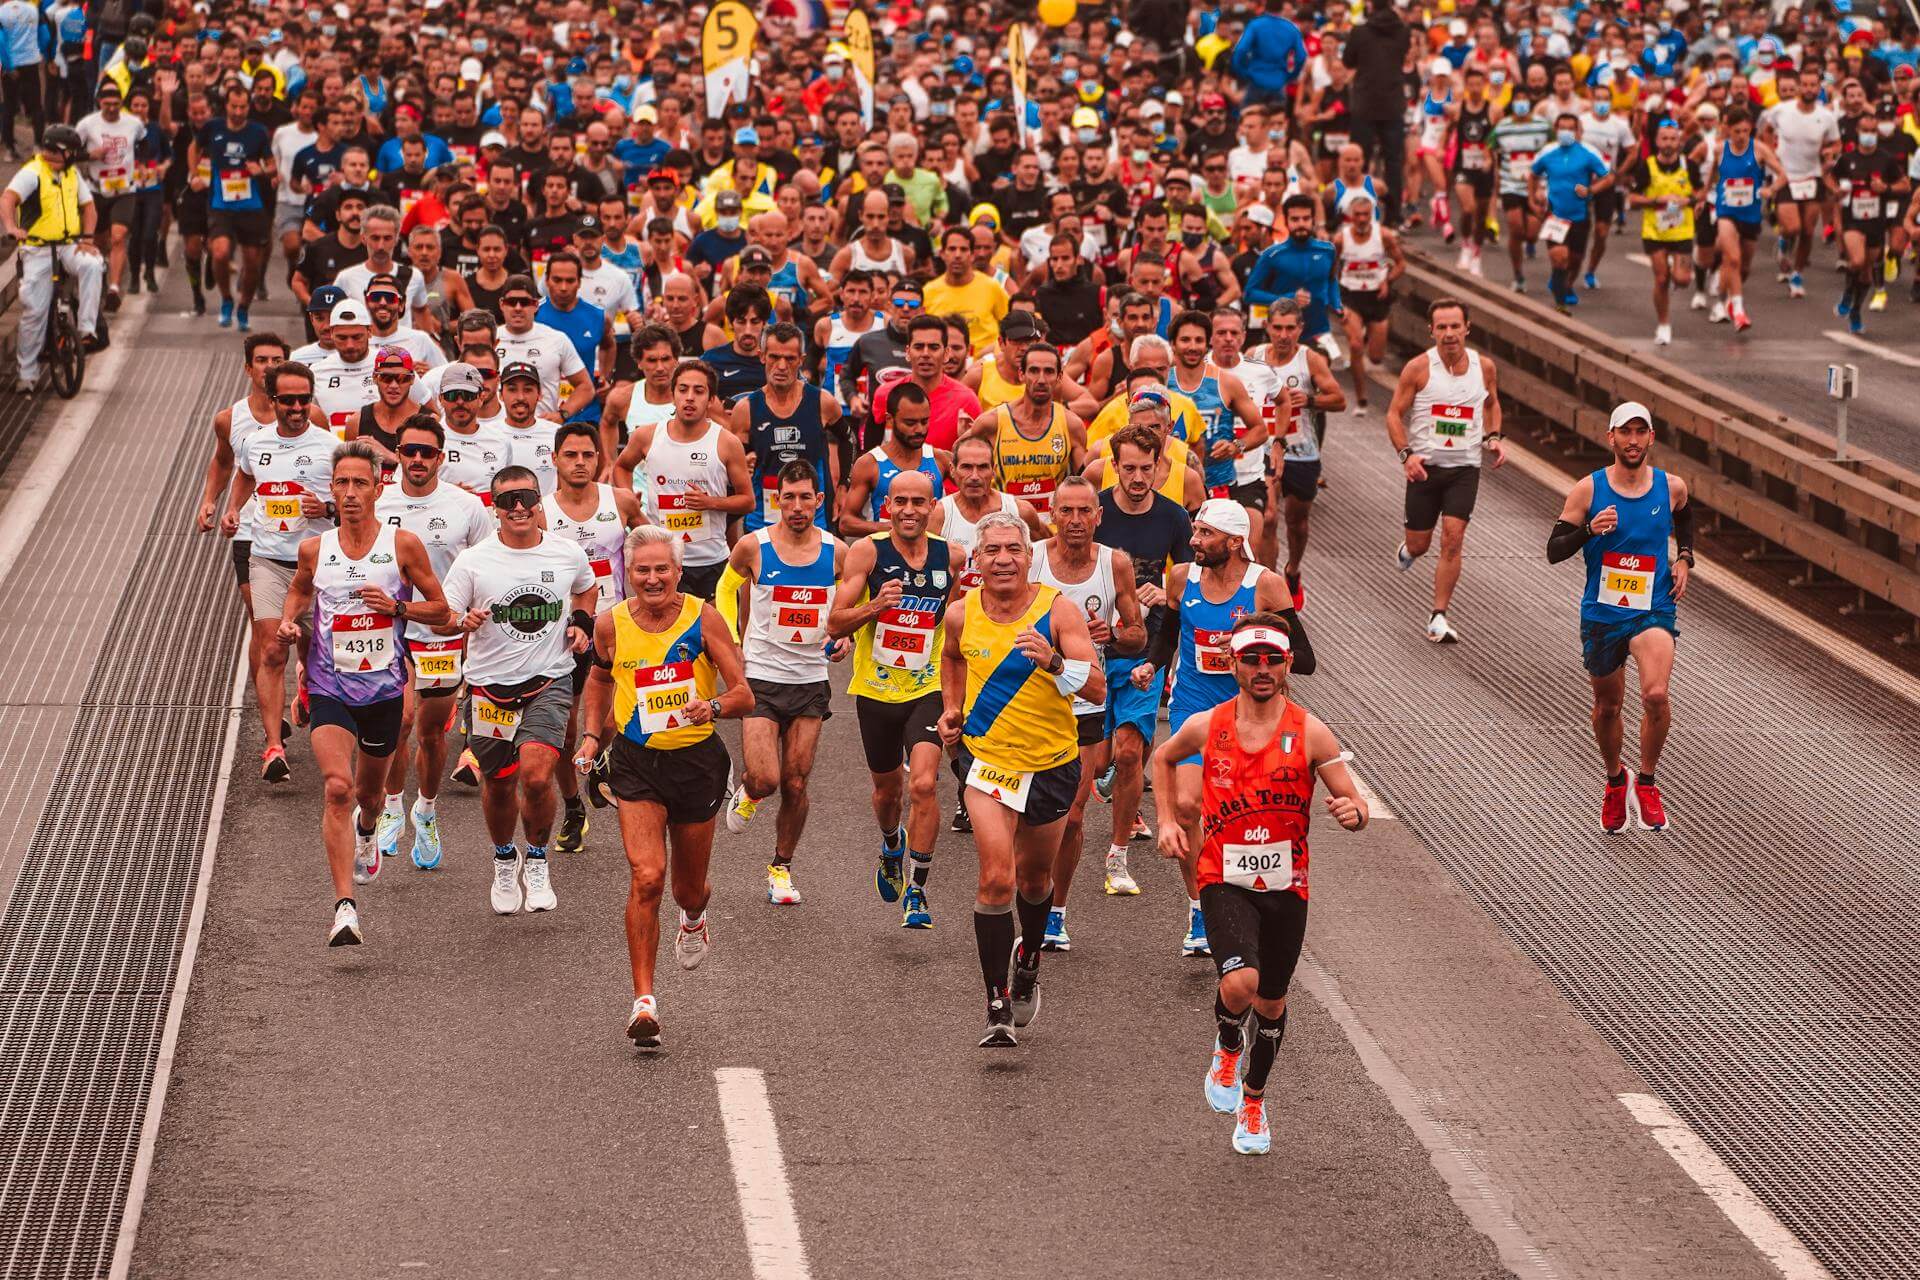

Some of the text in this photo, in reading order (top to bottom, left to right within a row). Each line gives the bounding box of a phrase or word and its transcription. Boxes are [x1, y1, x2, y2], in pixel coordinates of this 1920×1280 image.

[715, 10, 738, 50] 5
[325, 294, 334, 304] U
[258, 453, 272, 466] B
[448, 450, 461, 463] B
[270, 483, 289, 495] edp
[1023, 482, 1041, 494] edp
[271, 504, 292, 515] 209
[667, 516, 703, 529] 10422
[1619, 555, 1640, 571] edp
[1615, 578, 1638, 591] 178
[504, 585, 552, 603] DIRECTIVO
[791, 588, 813, 604] edp
[351, 615, 374, 630] edp
[787, 613, 812, 625] 456
[898, 612, 919, 629] edp
[509, 629, 548, 641] ULTRAS
[890, 635, 917, 649] 255
[345, 638, 385, 653] 4318
[420, 660, 455, 672] 10421
[653, 665, 678, 683] edp
[647, 691, 690, 711] 10400
[478, 707, 515, 723] 10416
[980, 767, 1021, 791] 10410
[1243, 824, 1270, 844] edp
[1237, 852, 1282, 870] 4902
